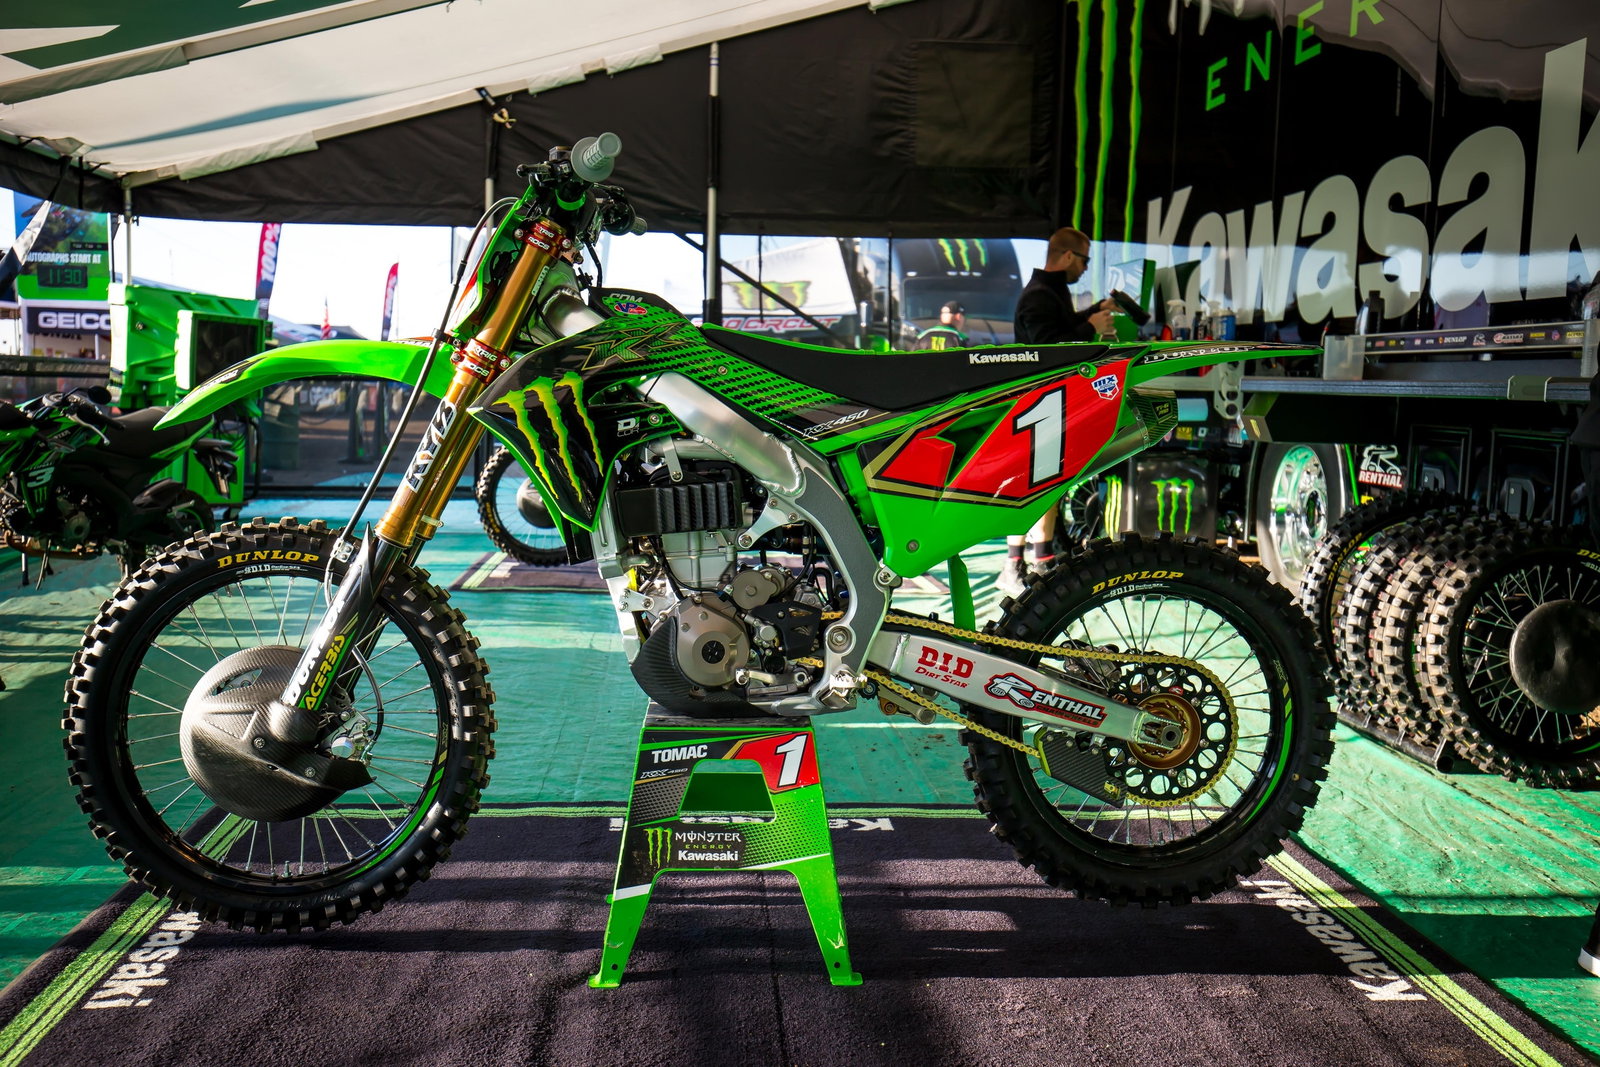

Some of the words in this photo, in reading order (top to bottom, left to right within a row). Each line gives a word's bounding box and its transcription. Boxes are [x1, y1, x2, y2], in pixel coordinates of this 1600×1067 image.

[70, 253, 91, 264] START
[92, 253, 101, 264] AT
[969, 351, 1039, 364] Kawasaki
[1014, 386, 1065, 488] 1
[26, 466, 55, 488] 3
[1359, 470, 1403, 488] RENTHAL
[217, 550, 319, 568] DUNLOP
[1091, 570, 1185, 595] DUNLOP
[652, 744, 708, 764] TOMAC
[774, 733, 809, 788] 1
[675, 831, 742, 843] MONSTER
[678, 850, 738, 861] Kawasaki
[1239, 880, 1428, 1001] Kawasaki
